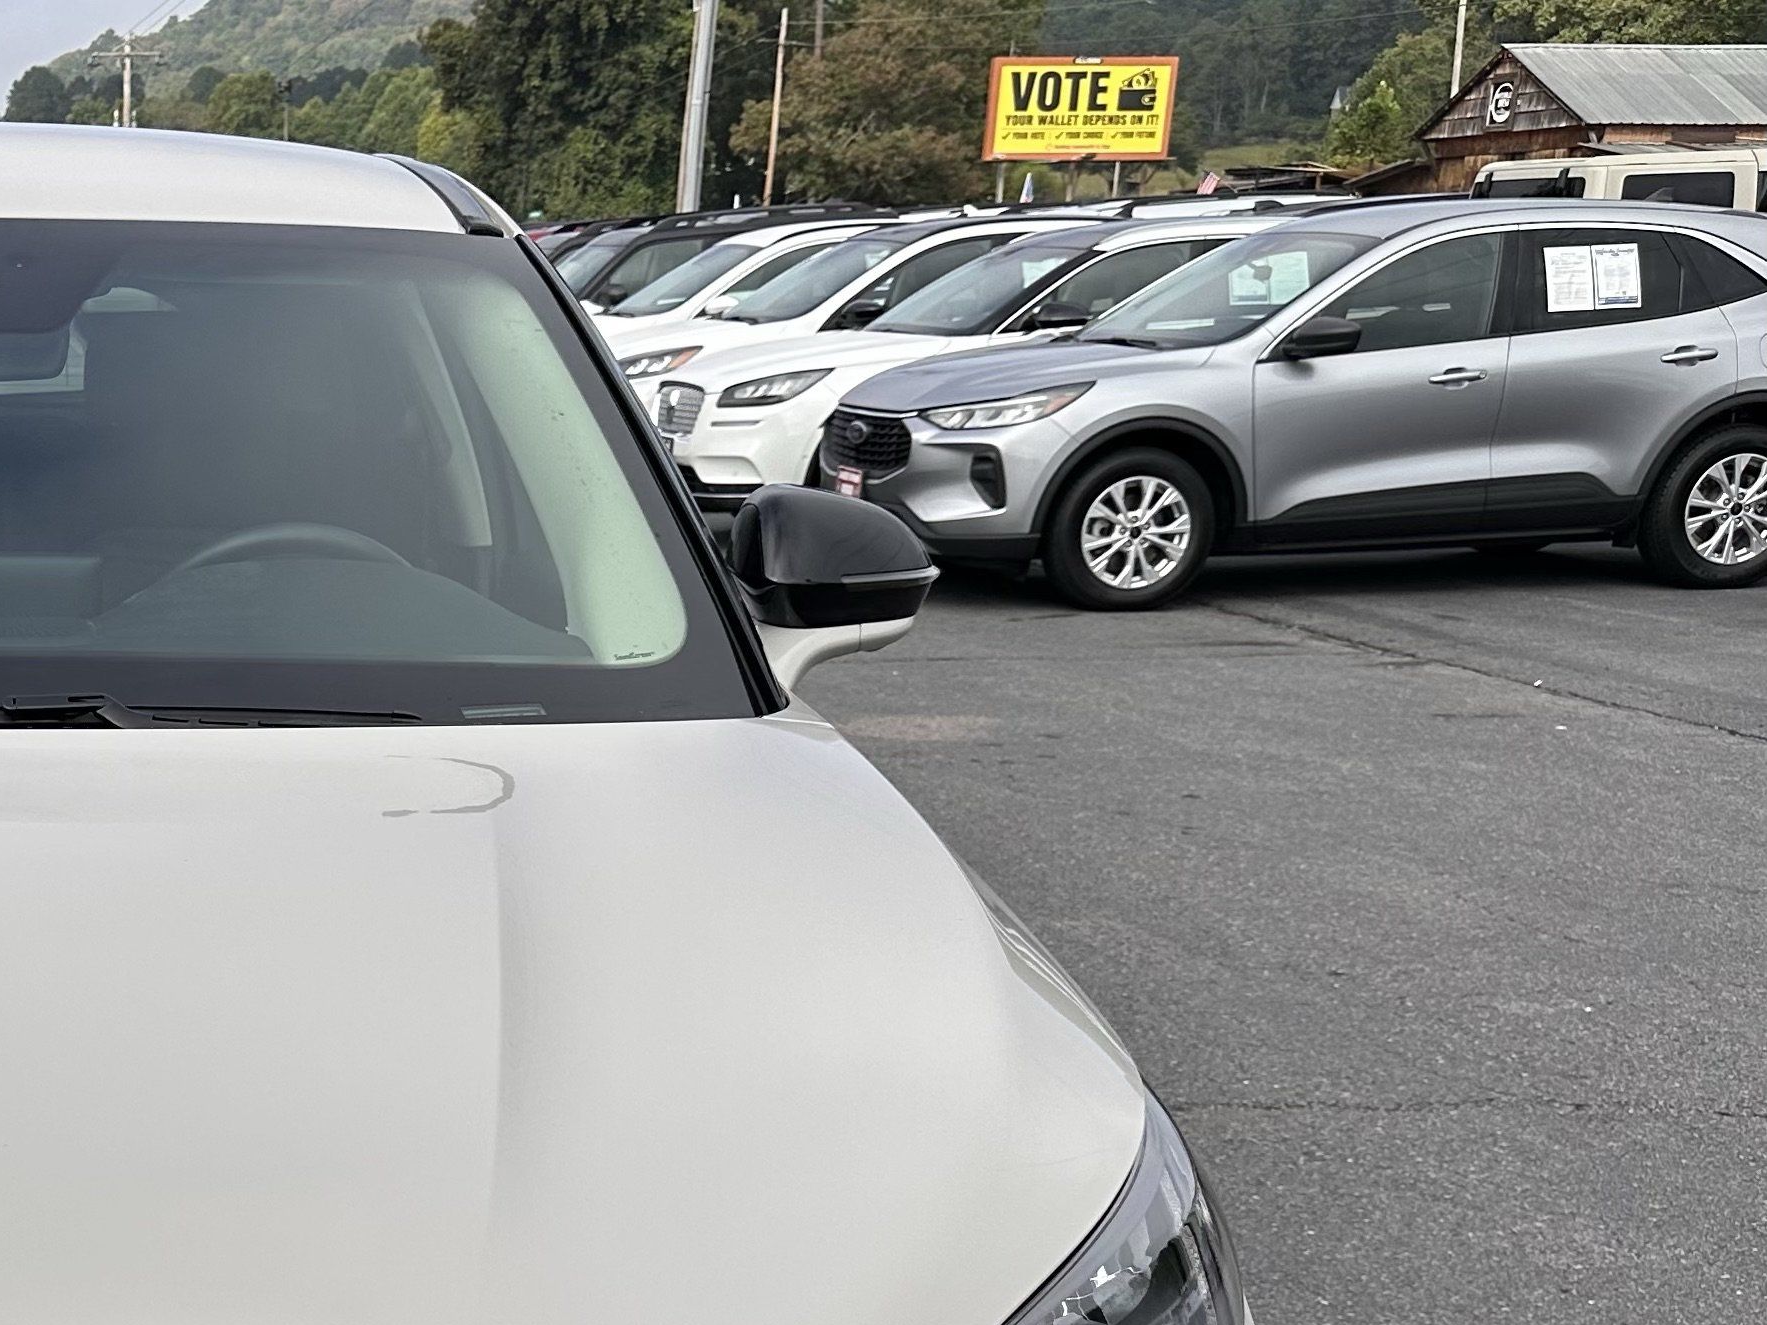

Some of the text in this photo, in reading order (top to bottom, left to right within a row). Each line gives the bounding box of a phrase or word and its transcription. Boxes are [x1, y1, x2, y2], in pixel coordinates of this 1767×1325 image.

[1011, 71, 1110, 112] VOTE
[1005, 114, 1160, 126] YOUR WALLET DEPENDS ON IT!
